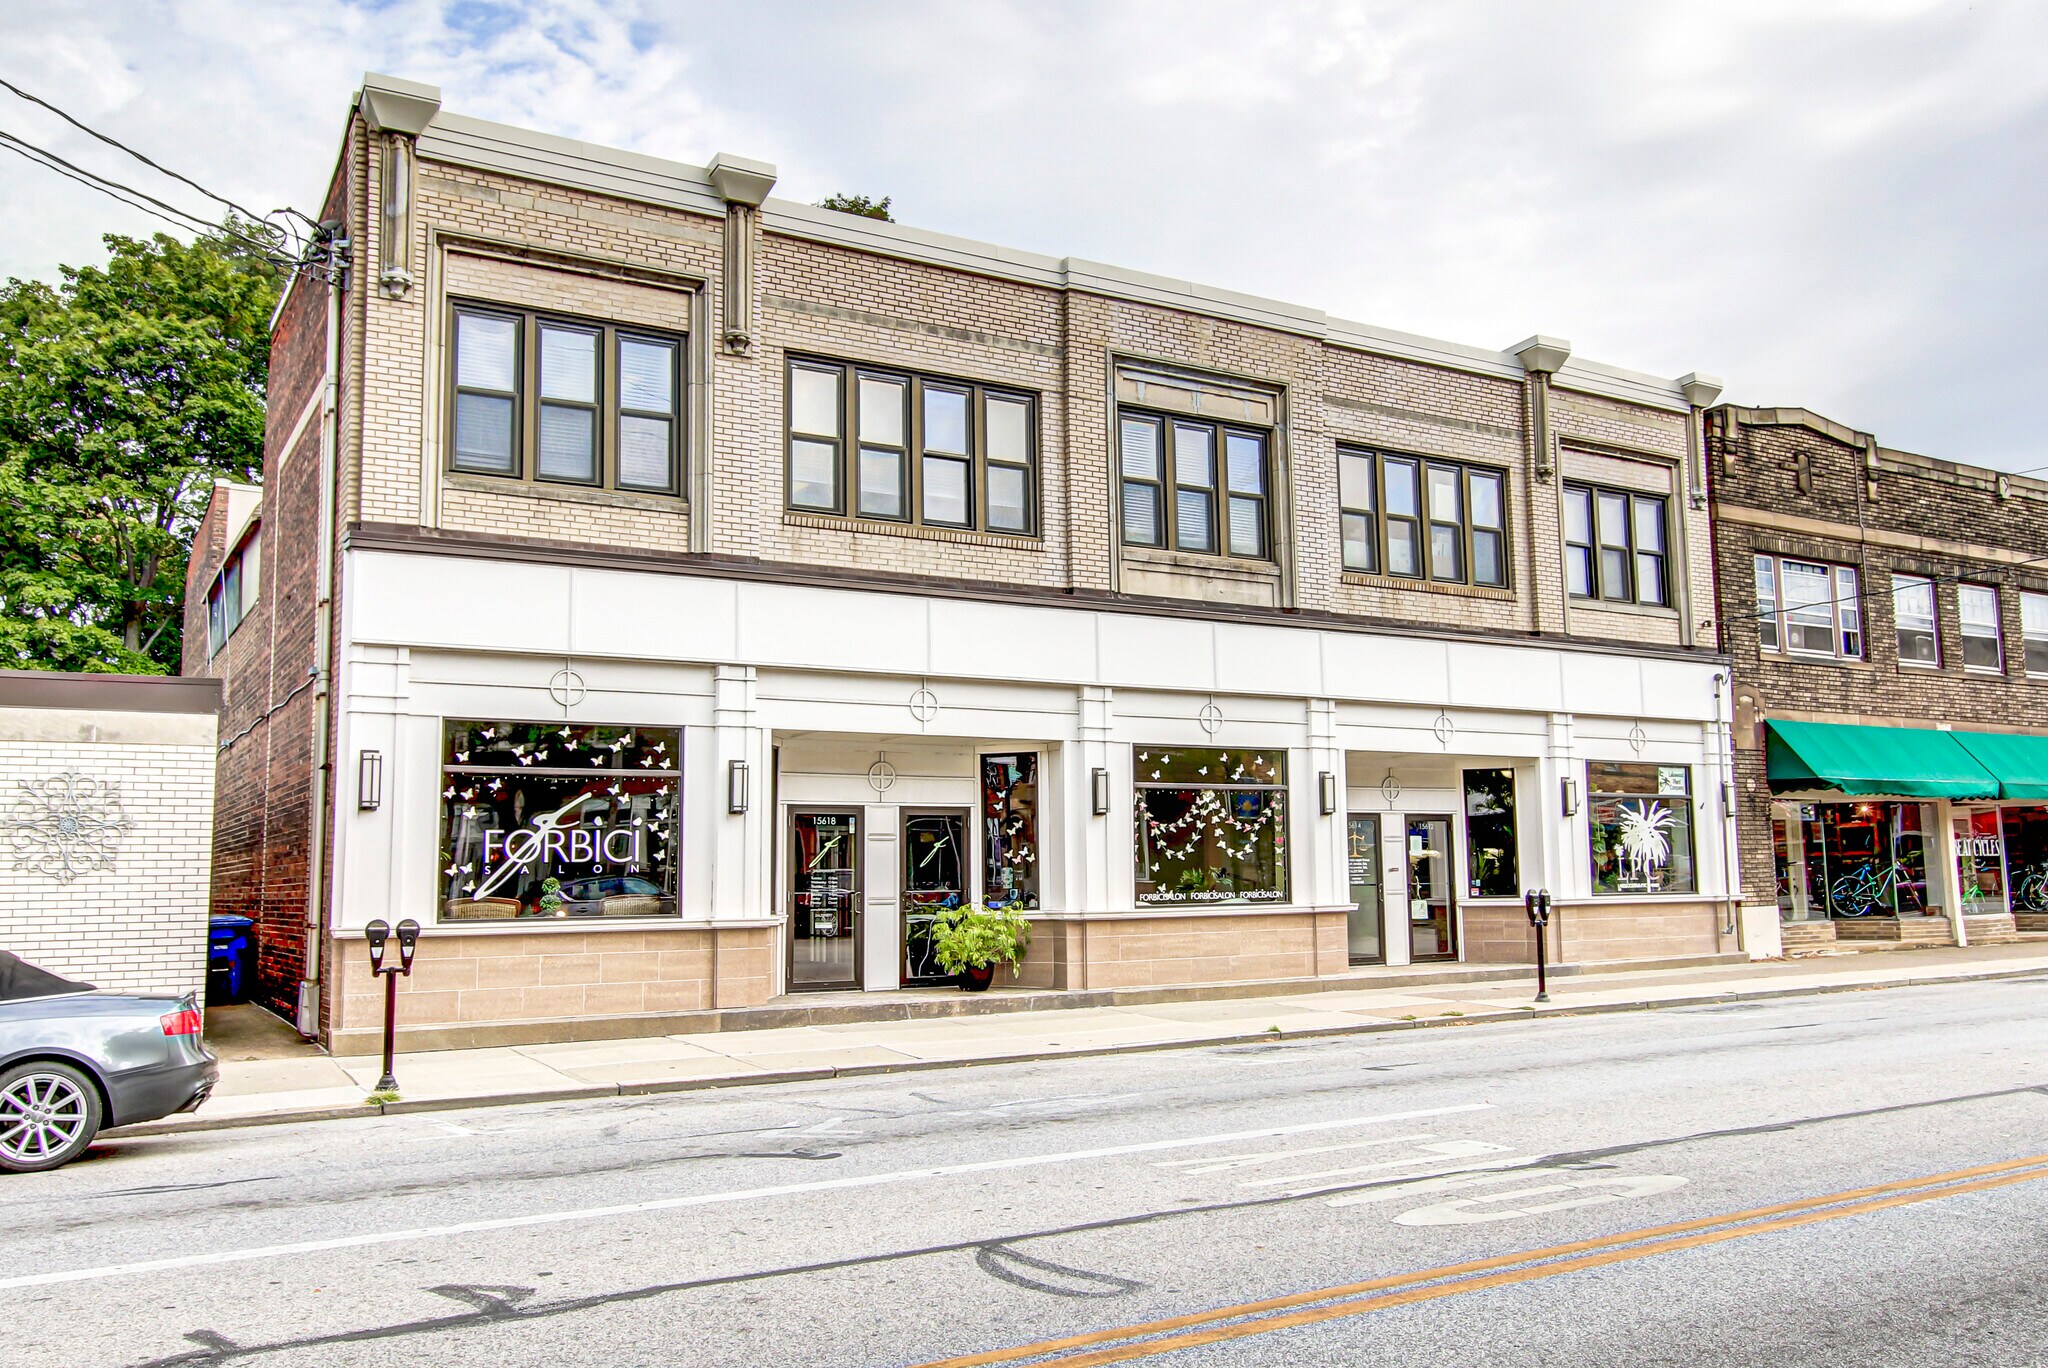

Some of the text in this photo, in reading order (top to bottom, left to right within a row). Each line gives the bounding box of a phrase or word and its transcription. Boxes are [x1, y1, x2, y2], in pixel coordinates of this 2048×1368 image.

[813, 817, 836, 825] 15618
[1973, 839, 2000, 856] CYCLES
[484, 864, 640, 875] SALON
